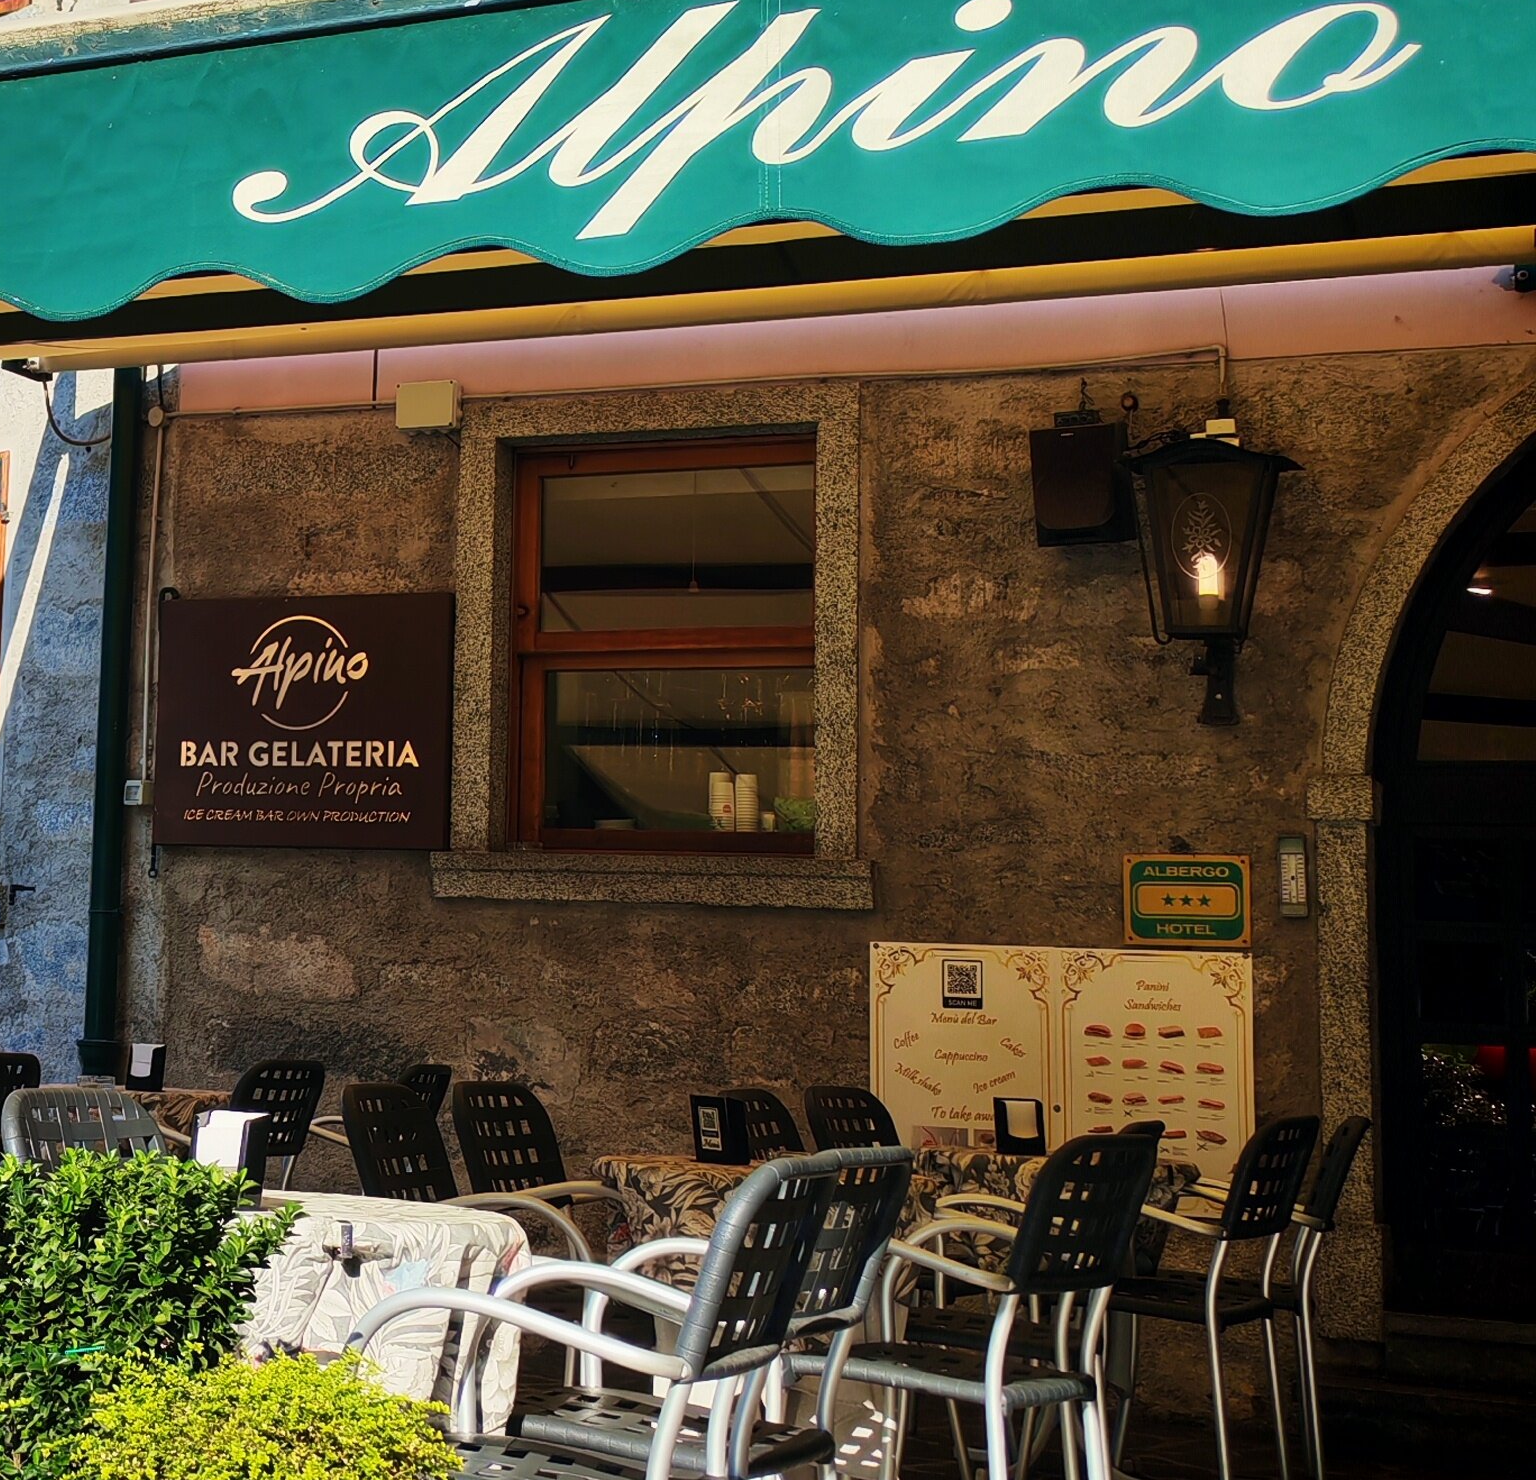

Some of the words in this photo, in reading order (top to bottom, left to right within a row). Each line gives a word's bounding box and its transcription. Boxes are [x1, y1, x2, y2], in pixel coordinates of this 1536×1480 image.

[231, 636, 369, 710] Alpino
[180, 741, 238, 767] BAR
[249, 741, 420, 767] GELATERIA
[196, 771, 311, 797] Produzione
[318, 771, 403, 804] Propria
[183, 809, 205, 820] ICE
[206, 809, 253, 821] CREAM
[255, 810, 284, 821] BAR
[286, 810, 321, 822] OWN
[322, 811, 411, 823] PRODUCTION
[1143, 866, 1229, 877] ALBERGO
[1156, 923, 1216, 935] HOTEL
[1136, 980, 1170, 992] Panini
[1124, 998, 1182, 1012] Sandwiches
[960, 1011, 978, 1025] del
[976, 1014, 998, 1025] Bar
[893, 1031, 920, 1049] Coffee
[1000, 1038, 1026, 1057] Cakes
[934, 1049, 989, 1065] Cappuccino
[972, 1082, 988, 1095] Ice
[989, 1071, 1016, 1088] cream
[931, 1105, 946, 1119] To
[949, 1105, 972, 1122] take
